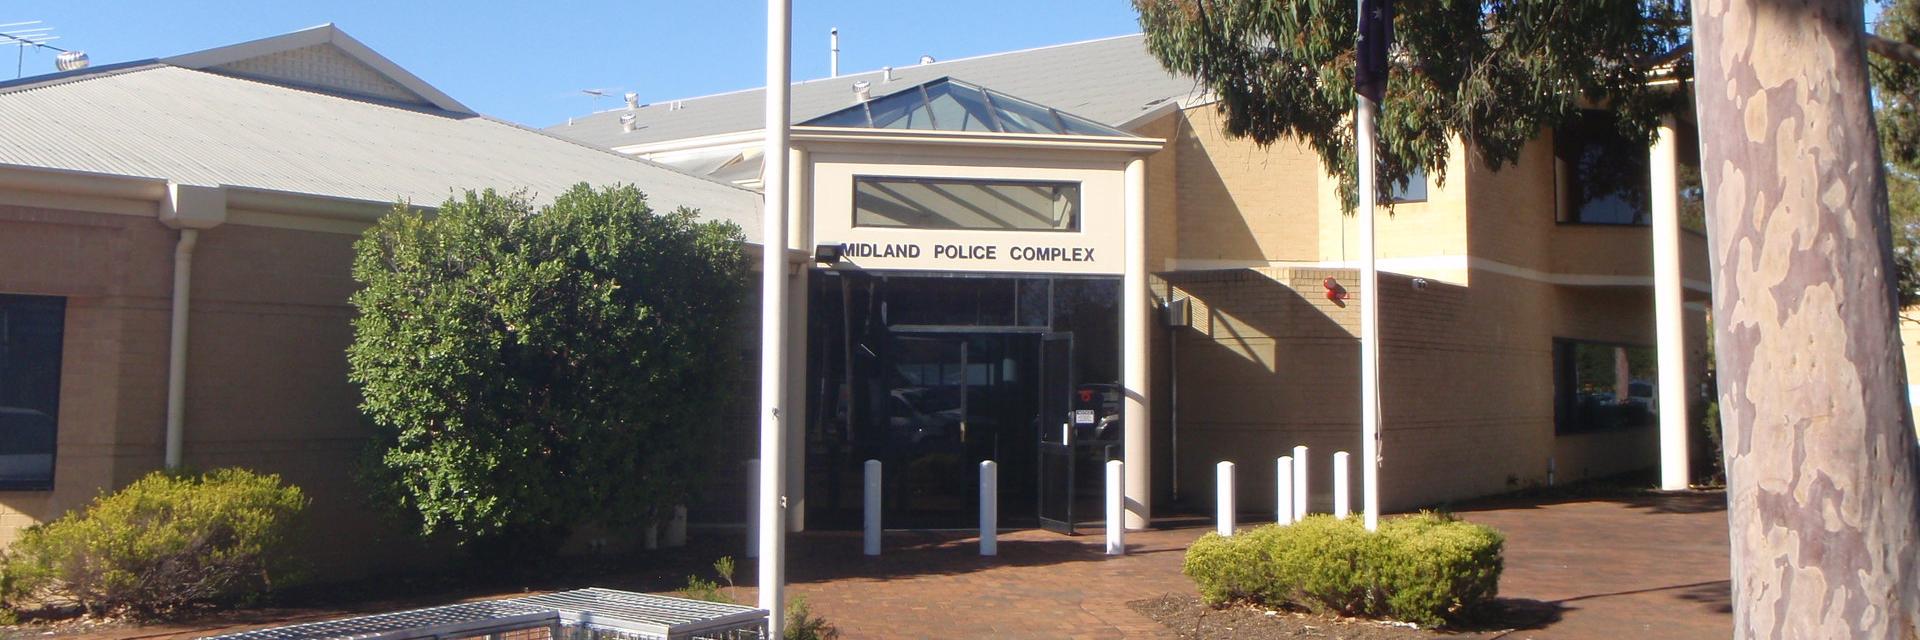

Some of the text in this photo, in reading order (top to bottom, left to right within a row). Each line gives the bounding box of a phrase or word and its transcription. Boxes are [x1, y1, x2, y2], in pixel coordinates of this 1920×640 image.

[840, 243, 1095, 262] MIDLAND POLICE COMPLEX
